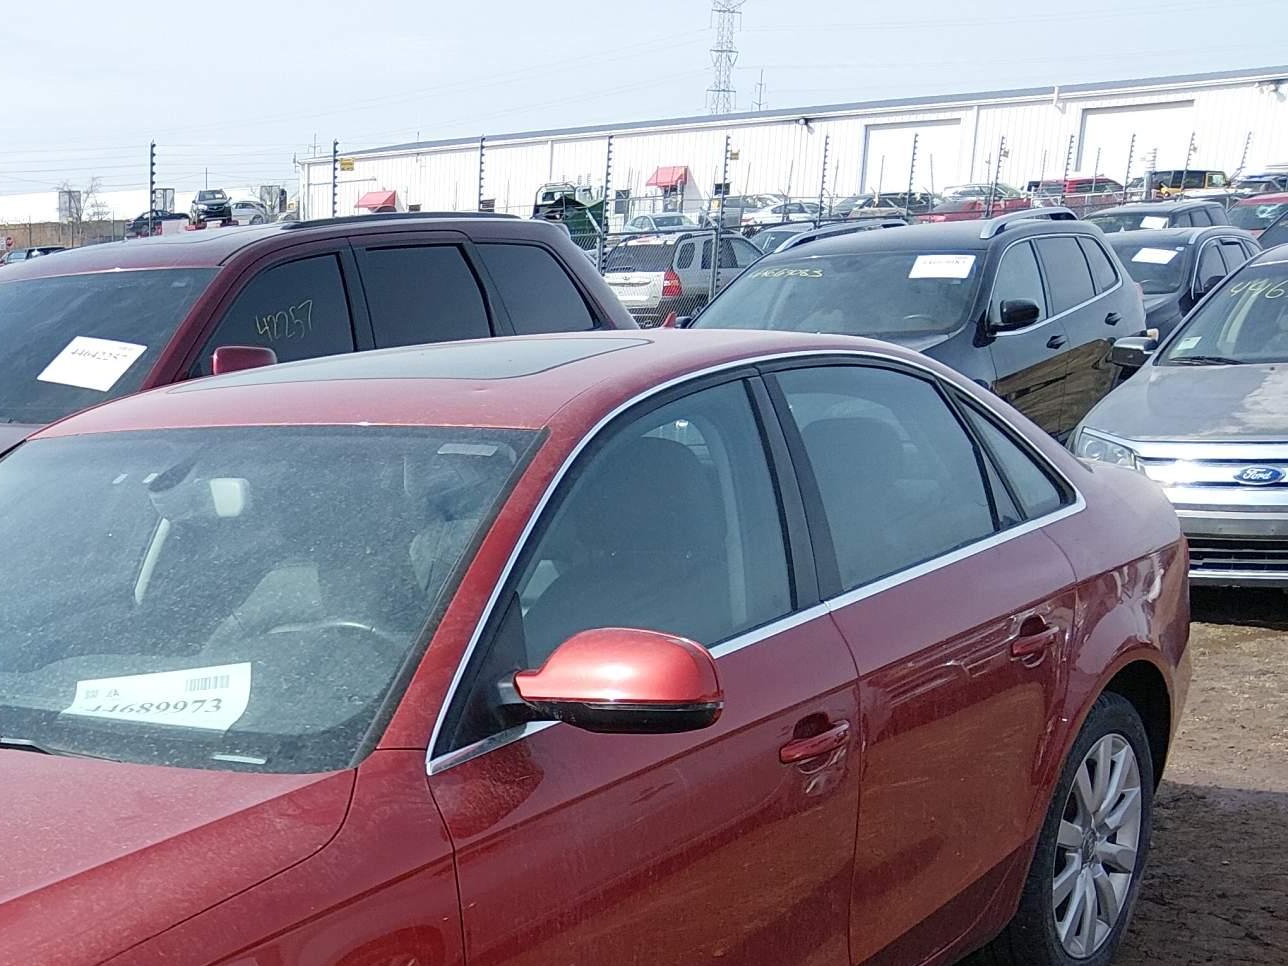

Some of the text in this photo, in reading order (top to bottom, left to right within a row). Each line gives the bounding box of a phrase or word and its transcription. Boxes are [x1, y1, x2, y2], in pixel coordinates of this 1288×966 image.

[1230, 278, 1288, 299] 446
[255, 299, 313, 341] 42257
[1242, 467, 1273, 481] Ford
